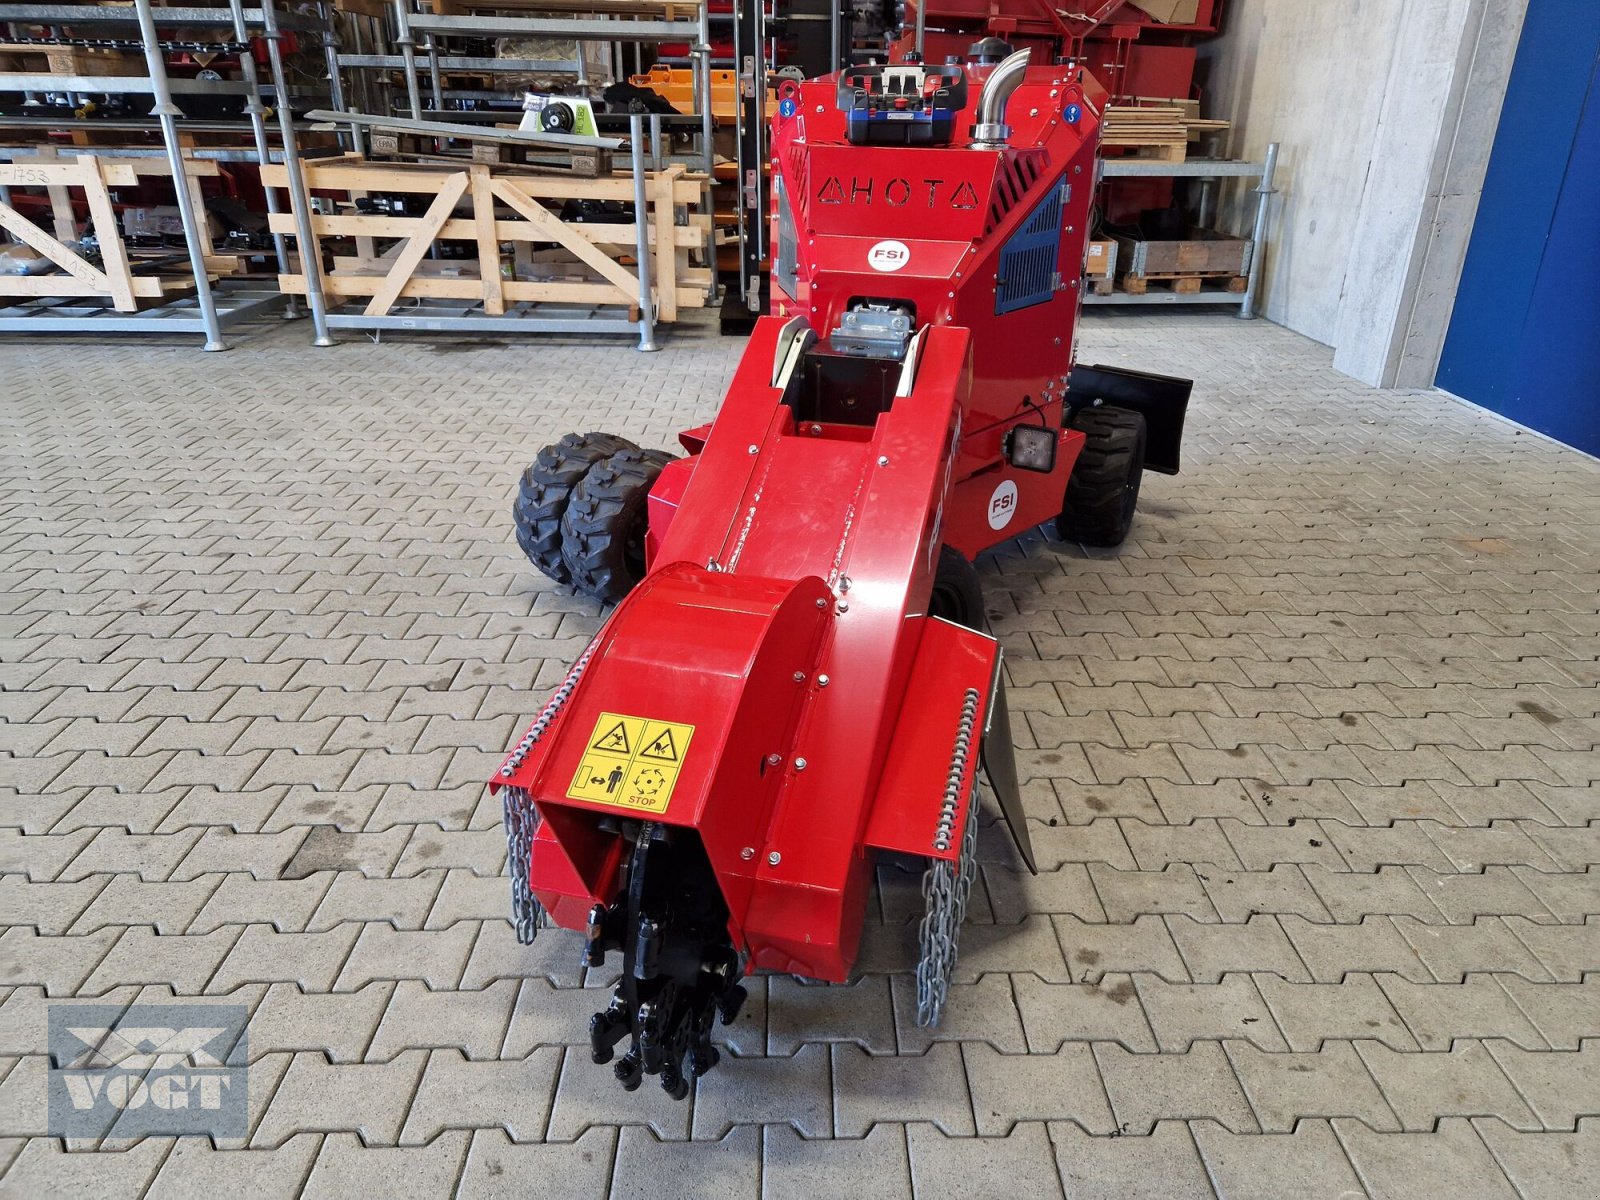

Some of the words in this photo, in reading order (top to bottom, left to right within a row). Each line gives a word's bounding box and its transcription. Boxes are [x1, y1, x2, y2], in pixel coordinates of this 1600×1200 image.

[577, 106, 585, 121] 182
[0, 169, 49, 184] -1753
[874, 249, 904, 260] FSI
[992, 493, 1013, 513] FSI
[628, 795, 656, 806] STOP
